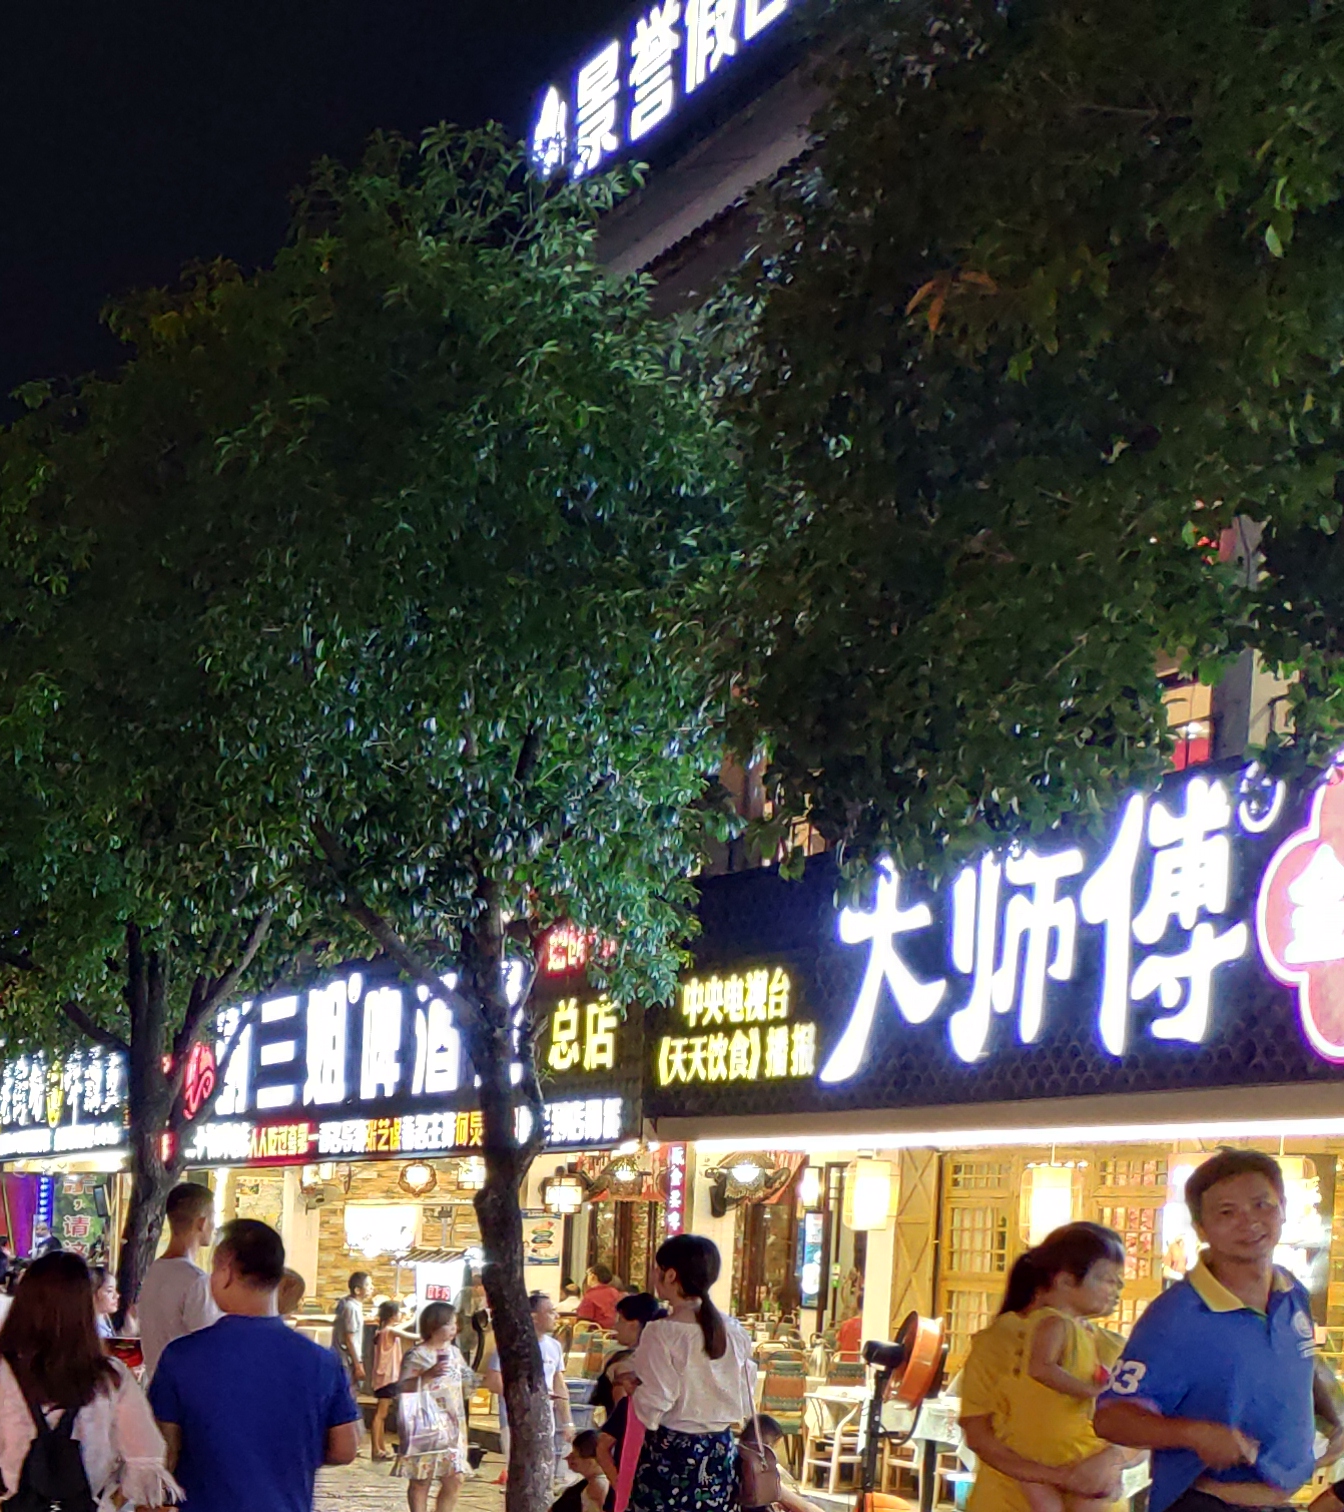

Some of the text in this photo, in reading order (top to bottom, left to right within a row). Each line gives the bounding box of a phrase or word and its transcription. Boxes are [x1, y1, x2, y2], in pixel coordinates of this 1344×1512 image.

[683, 966, 791, 1027] 中央电视台
[549, 994, 617, 1071] 总店
